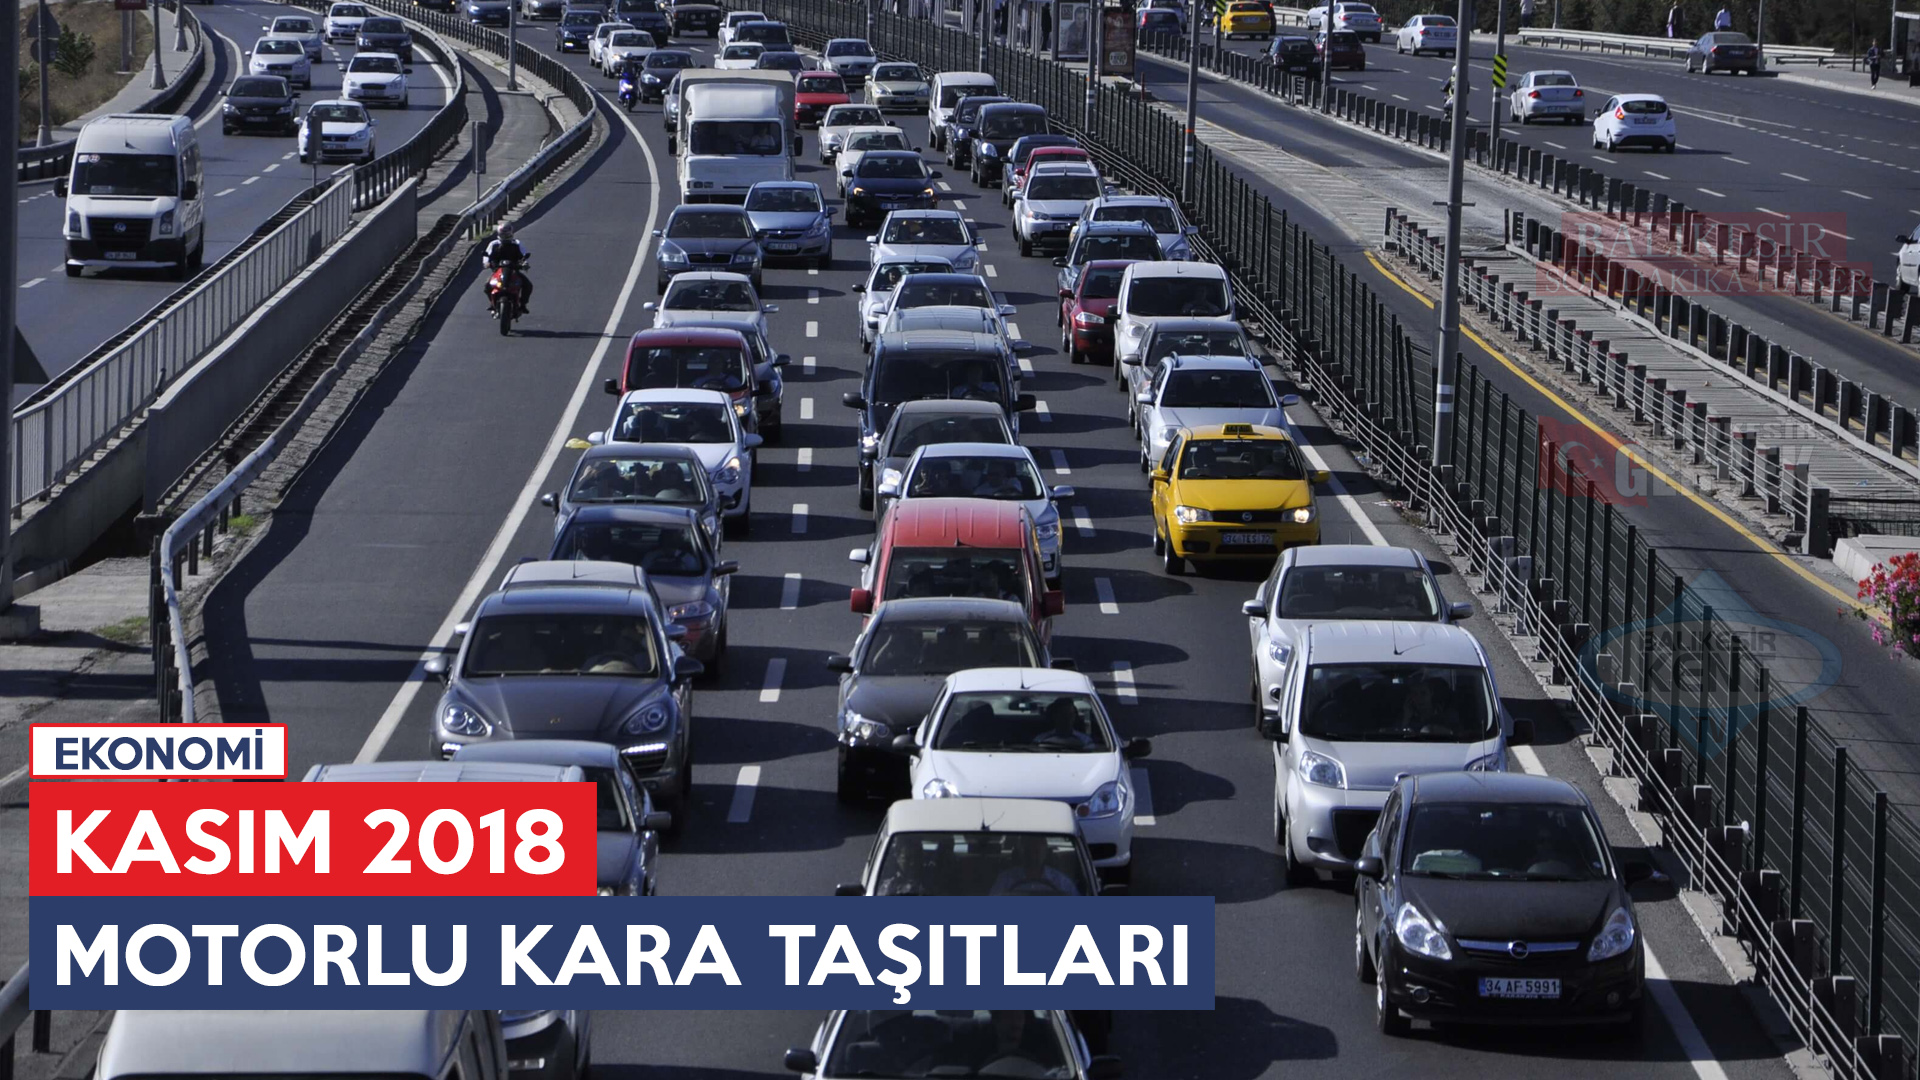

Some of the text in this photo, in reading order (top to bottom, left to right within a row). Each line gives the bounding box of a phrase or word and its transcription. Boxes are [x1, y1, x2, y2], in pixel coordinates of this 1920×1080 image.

[1486, 980, 1557, 993] 34 AF 5991
